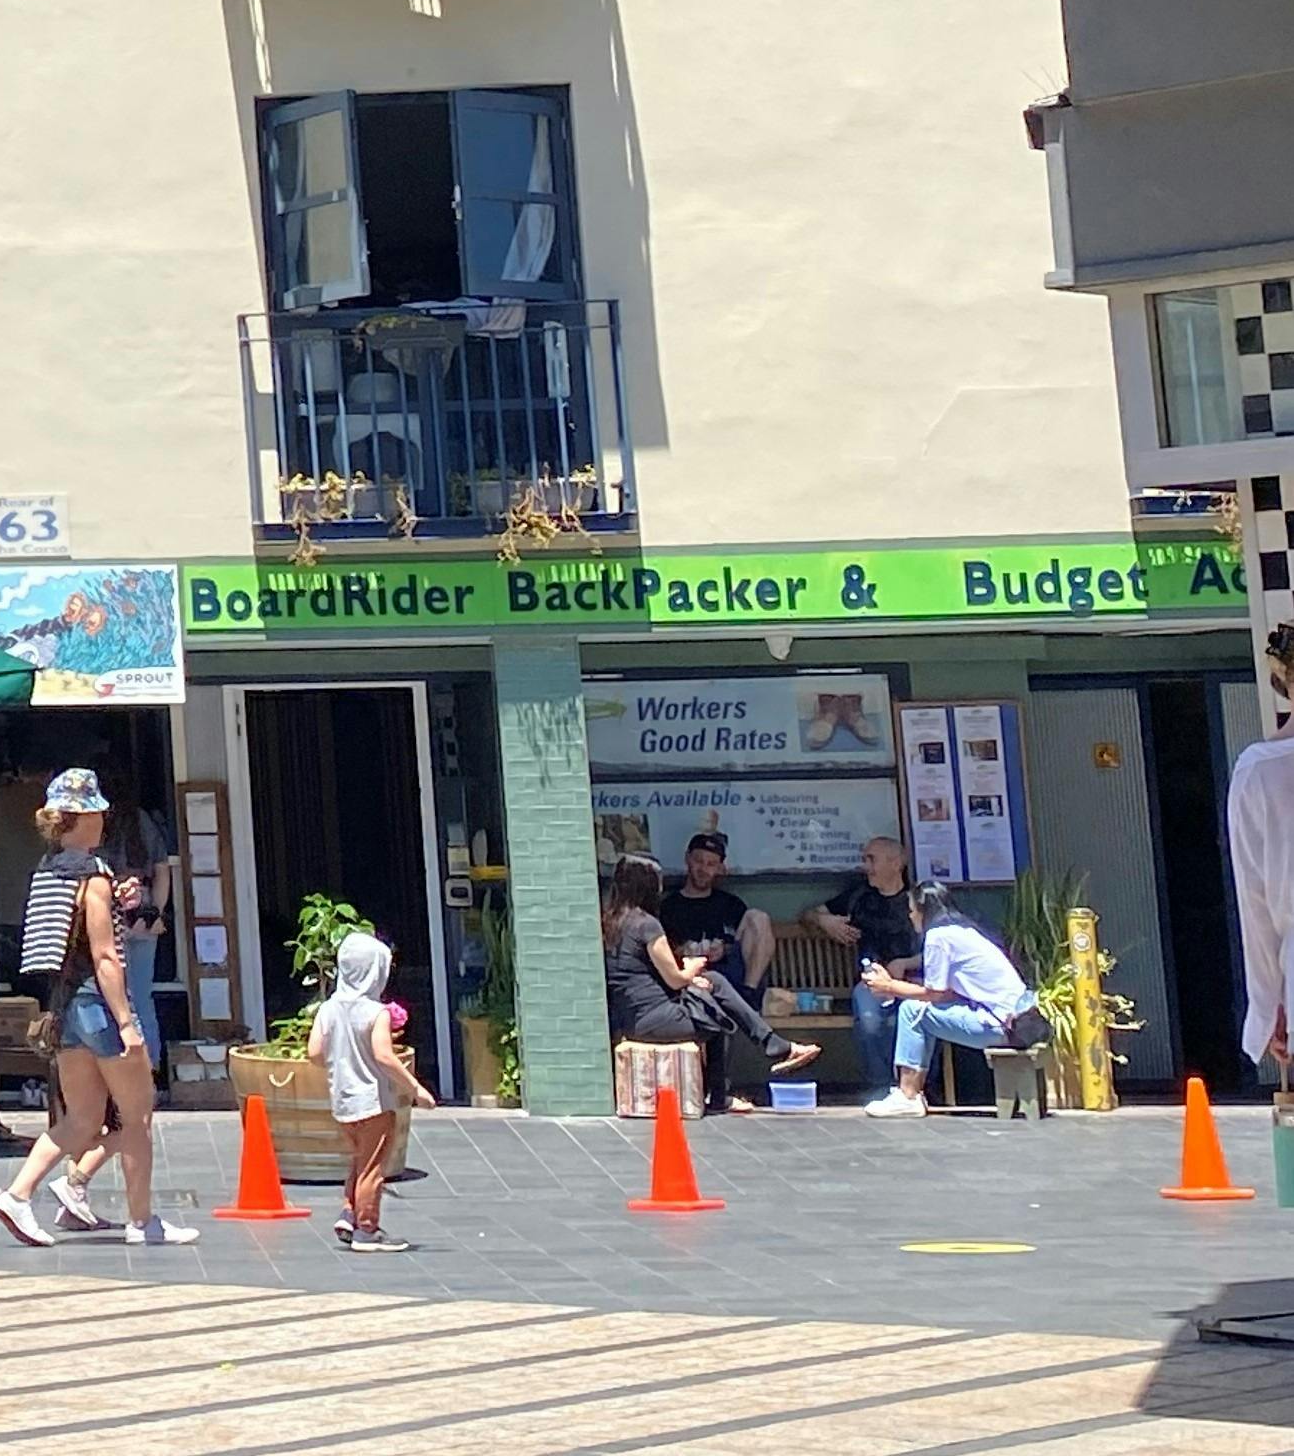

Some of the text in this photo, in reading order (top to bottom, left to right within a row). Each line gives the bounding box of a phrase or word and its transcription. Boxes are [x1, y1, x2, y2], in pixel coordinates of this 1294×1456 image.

[39, 496, 54, 507] of
[21, 544, 68, 554] Corso
[190, 573, 475, 622] BoardRider
[507, 566, 807, 613] BackPacker
[840, 563, 879, 610] &
[962, 557, 1149, 617] Budget
[116, 672, 173, 684] SPROUT
[636, 696, 747, 721] Workers
[639, 726, 788, 753] Good Rates
[646, 789, 742, 807] Available
[760, 793, 819, 805] Labouring
[770, 805, 840, 817] Waitressing
